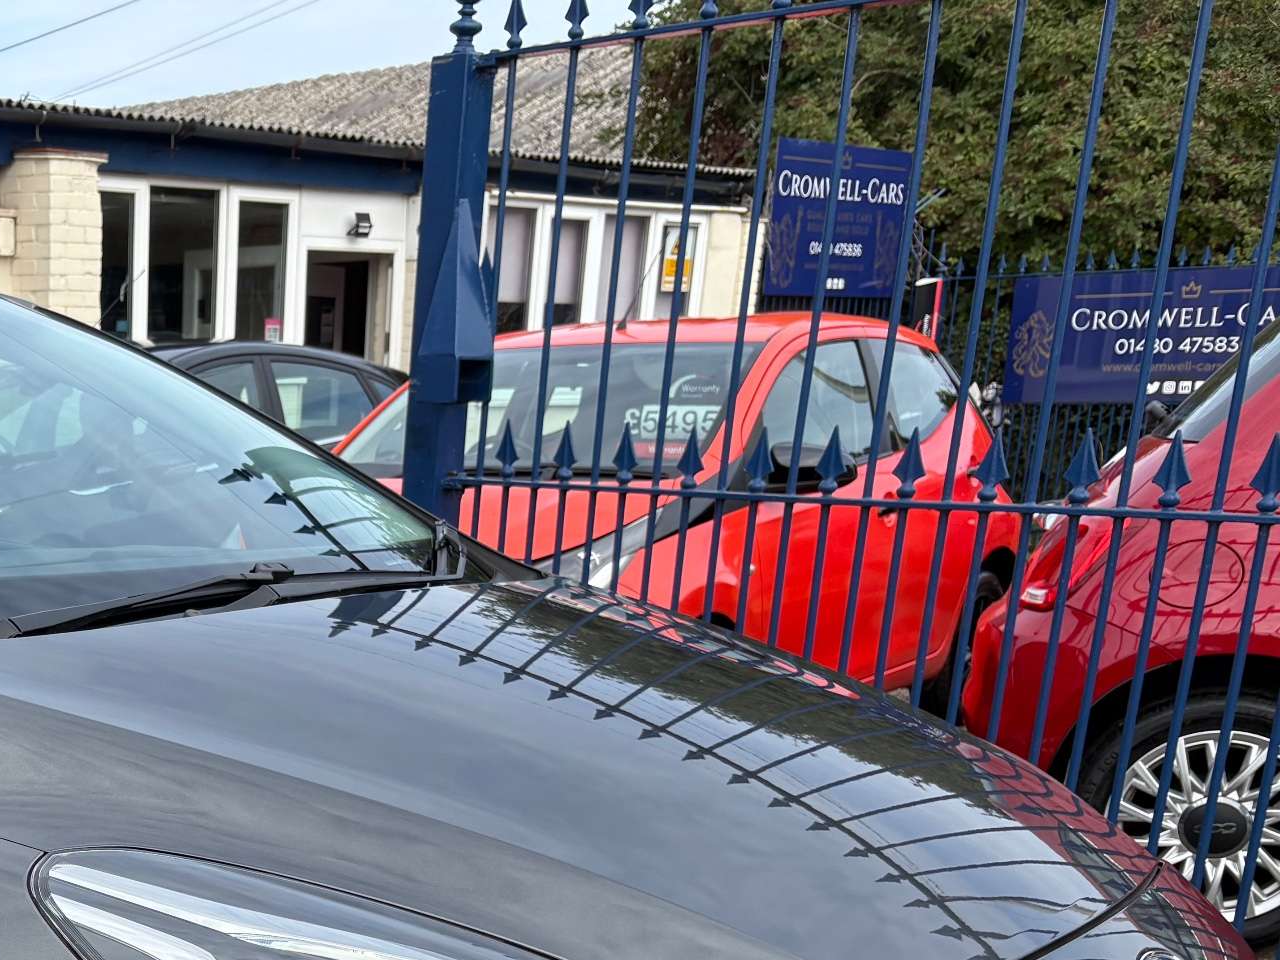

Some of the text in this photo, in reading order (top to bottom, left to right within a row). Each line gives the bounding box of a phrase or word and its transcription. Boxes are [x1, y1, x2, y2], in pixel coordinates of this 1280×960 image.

[778, 169, 905, 205] CROMELL-CARS
[1071, 303, 1276, 332] CROMWELL-CA
[1178, 336, 1240, 353] 47583
[681, 384, 720, 394] Warranty
[623, 408, 718, 436] £5495
